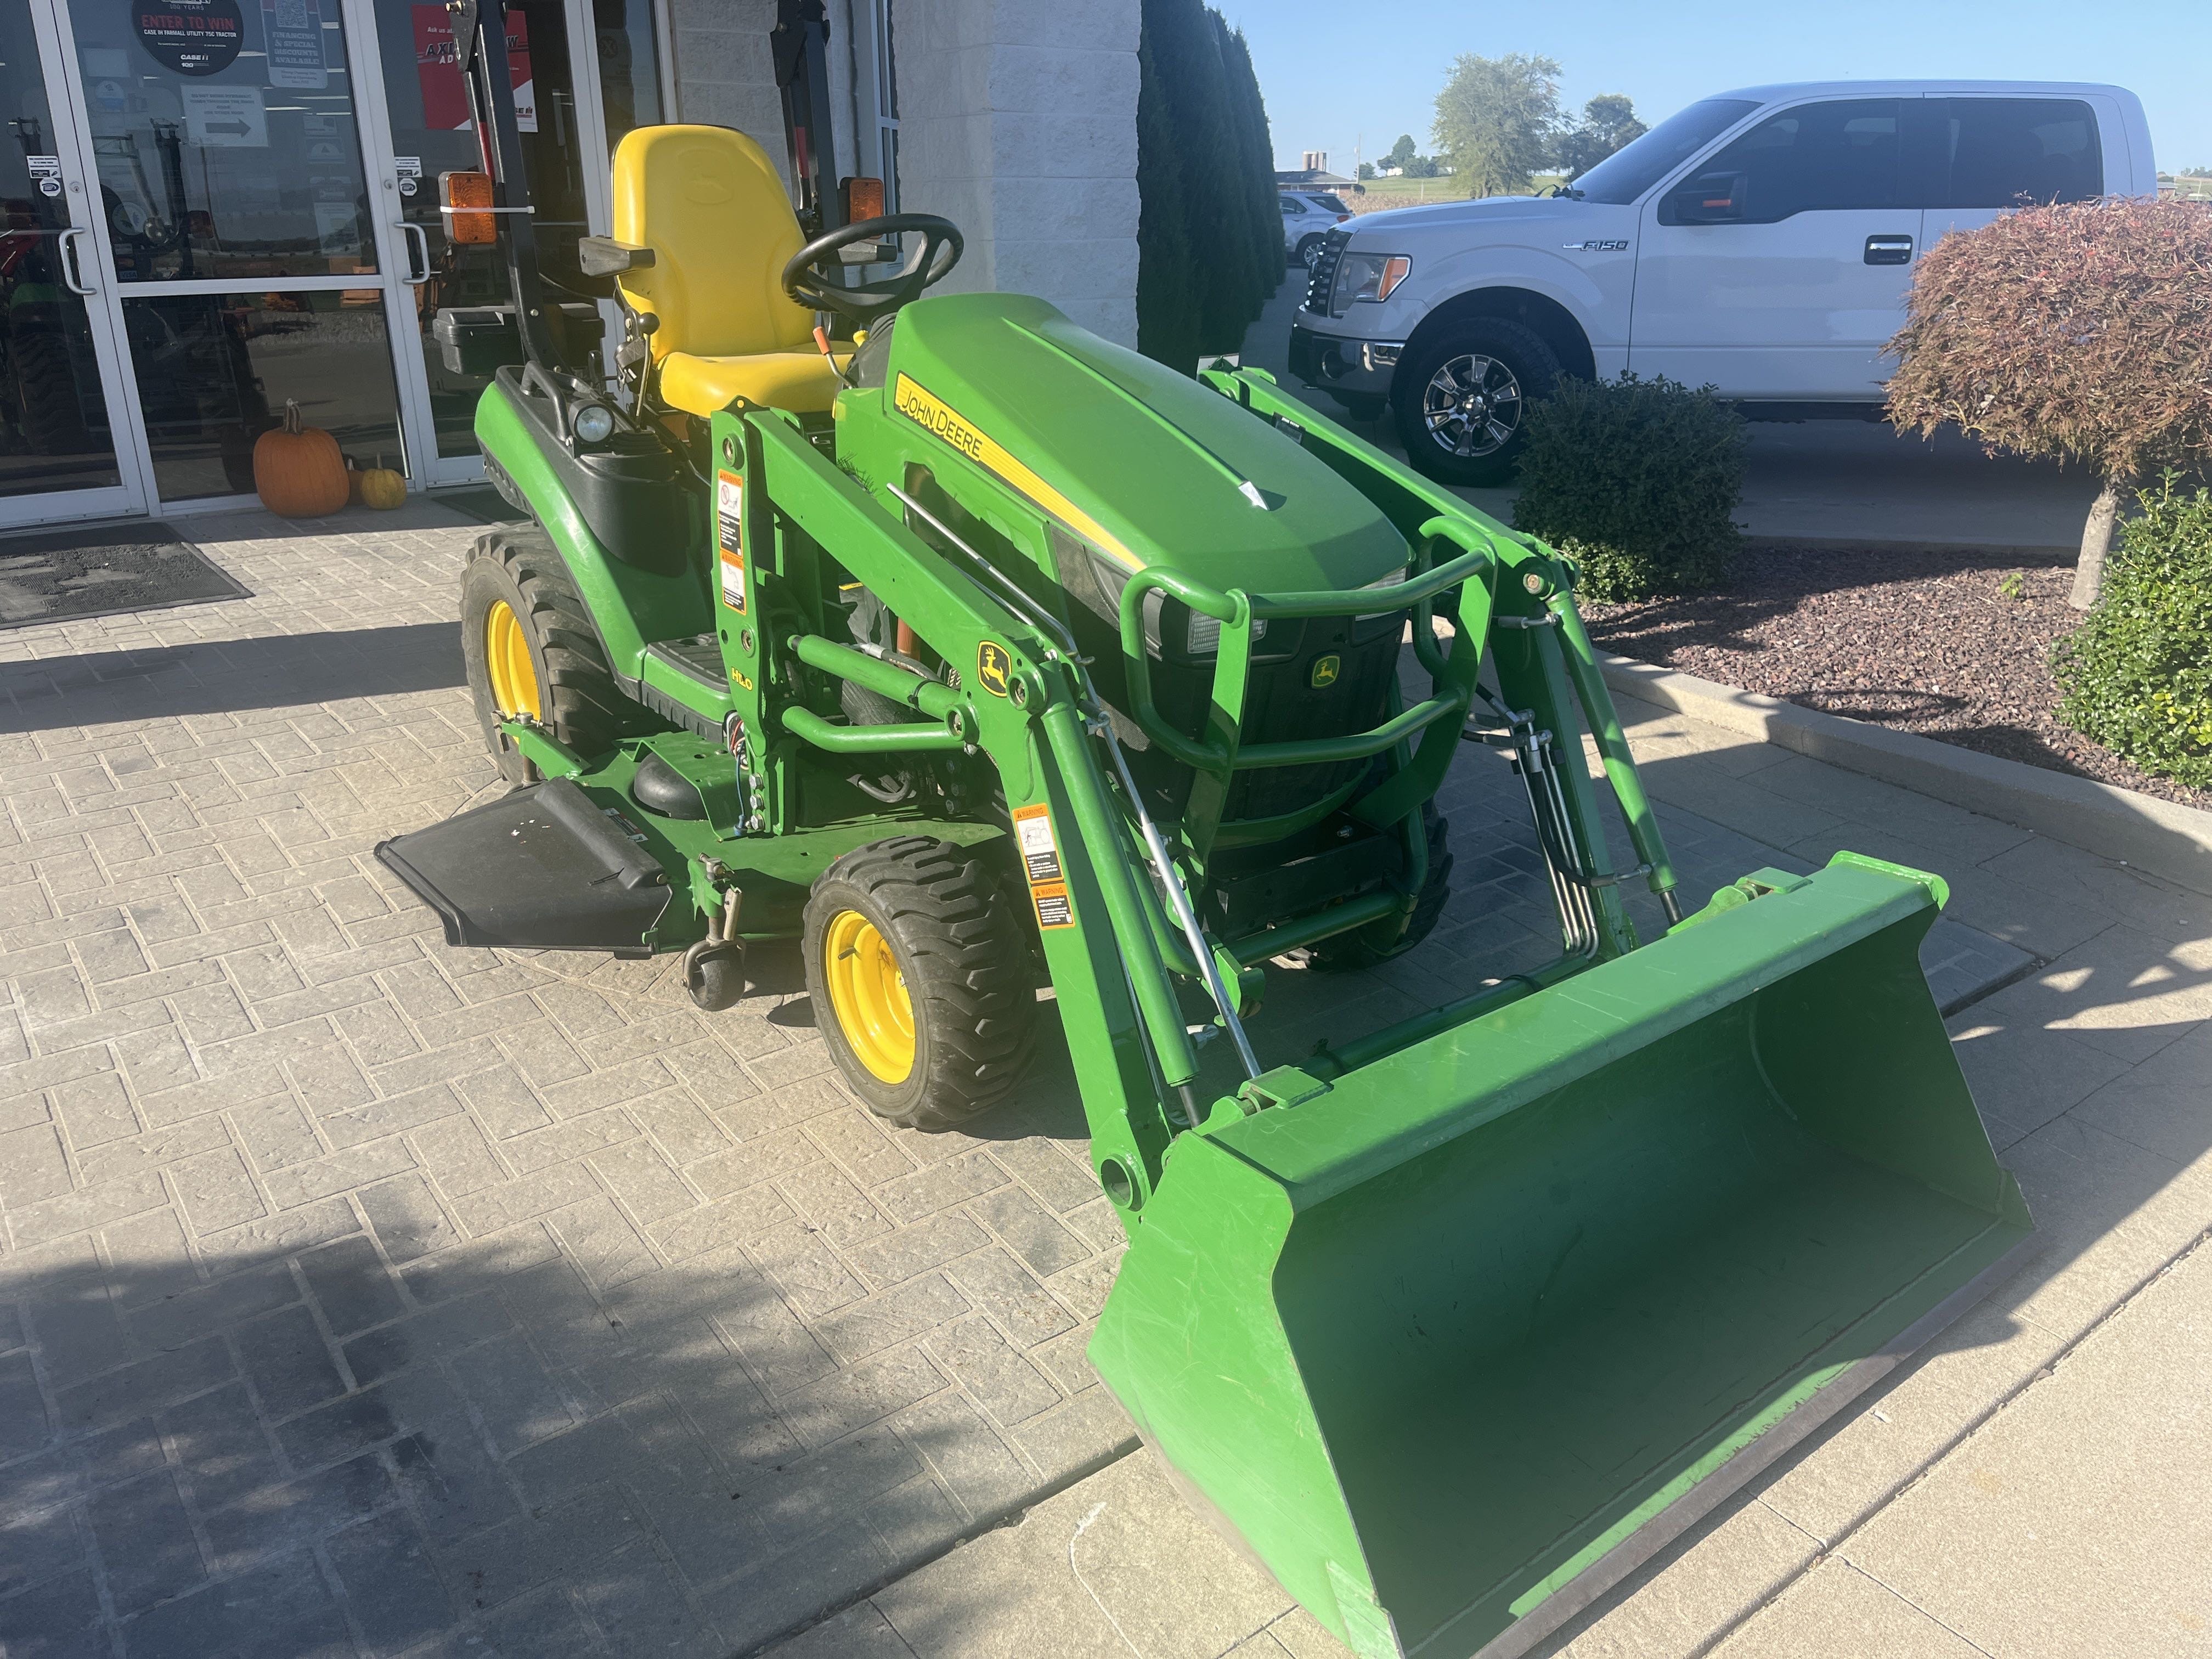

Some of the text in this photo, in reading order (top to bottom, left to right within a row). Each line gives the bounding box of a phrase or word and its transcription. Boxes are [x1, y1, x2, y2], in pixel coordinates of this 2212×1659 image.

[142, 14, 234, 30] ENTER TO WIN
[272, 31, 316, 40] FINANCING
[902, 390, 983, 458] JOHN DEERE
[1021, 807, 1044, 817] WARNING
[1041, 887, 1063, 896] WARNING
